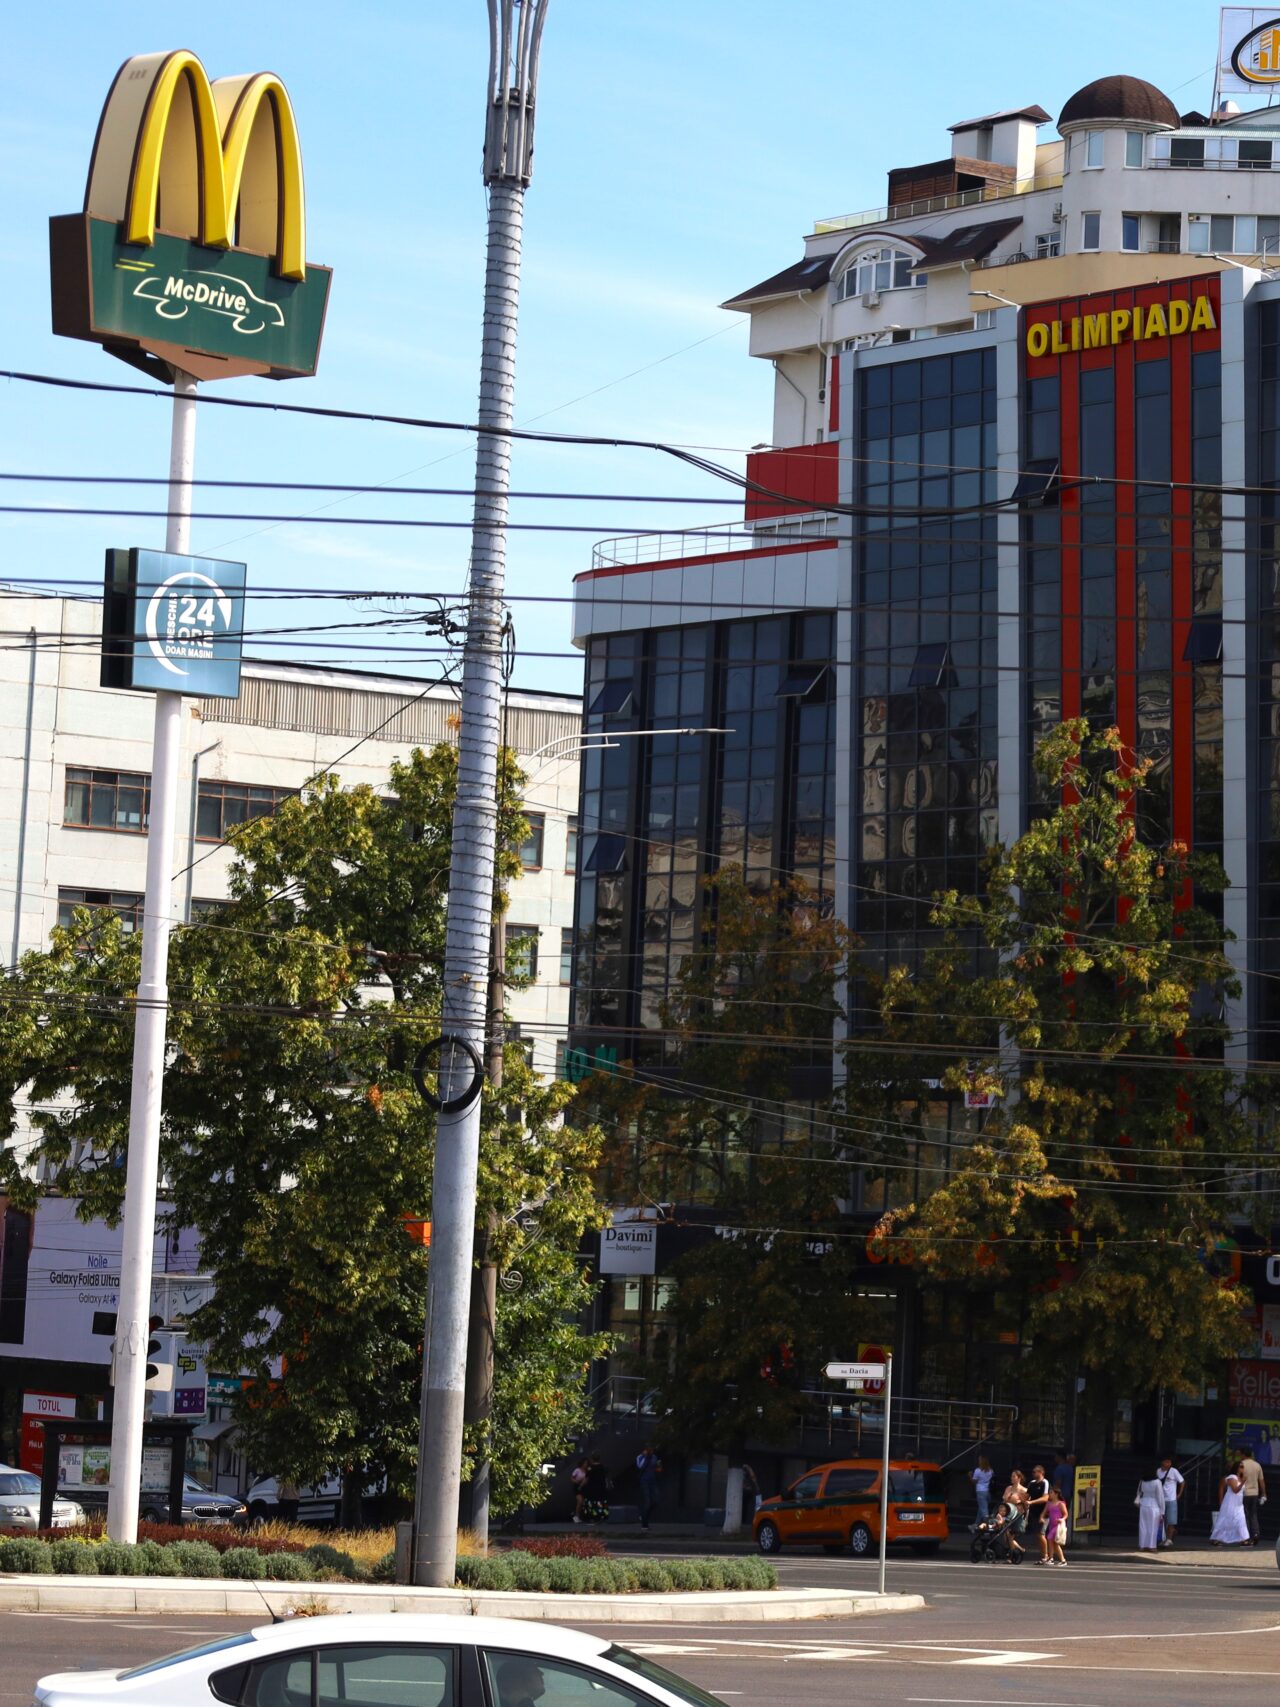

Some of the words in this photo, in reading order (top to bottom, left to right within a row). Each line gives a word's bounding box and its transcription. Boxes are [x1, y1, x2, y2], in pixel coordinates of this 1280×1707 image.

[1026, 295, 1217, 357] OLIMPIADA
[178, 594, 216, 627] 24
[177, 627, 214, 649] ORE
[165, 645, 187, 656] DOAR
[187, 649, 214, 659] MASINI
[605, 1228, 653, 1242] Davimi
[615, 1243, 642, 1253] boutique
[50, 1271, 77, 1288] Galaxy
[101, 1274, 120, 1287] Ultra
[79, 1292, 102, 1306] Galaxy
[849, 1367, 868, 1375] Dacia
[38, 1398, 61, 1412] TOTUL
